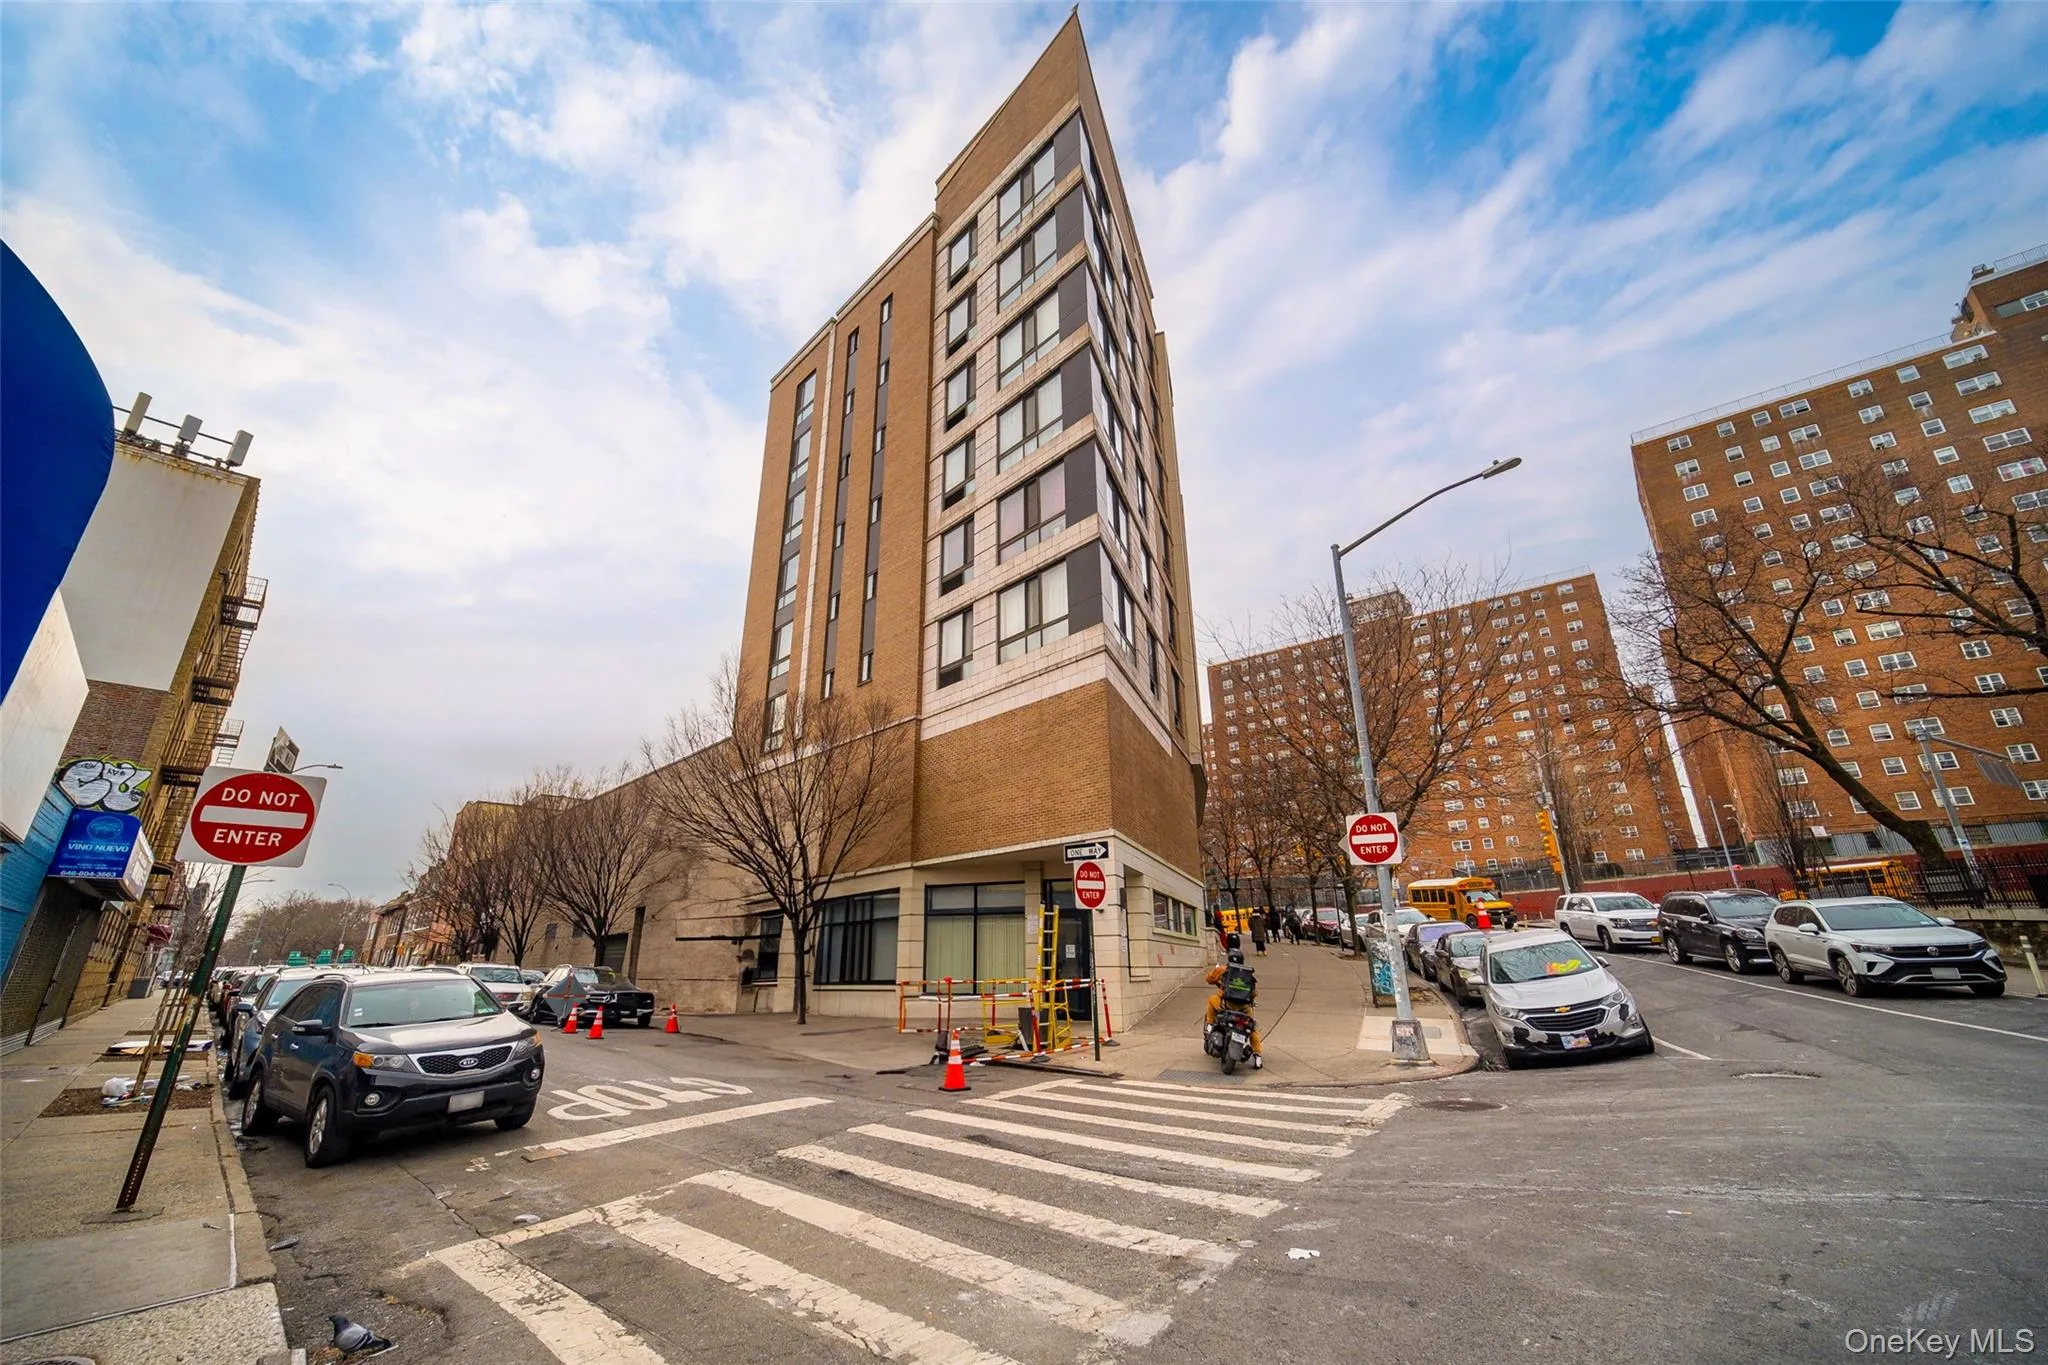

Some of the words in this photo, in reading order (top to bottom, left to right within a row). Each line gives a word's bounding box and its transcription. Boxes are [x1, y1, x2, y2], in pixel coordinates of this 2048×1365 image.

[221, 787, 251, 803] DO
[258, 790, 300, 807] NOT
[1355, 824, 1368, 833] DO
[1370, 823, 1387, 832] NOT
[213, 828, 282, 847] ENTER
[94, 845, 129, 853] NUEVO
[1070, 849, 1083, 857] ONE
[1088, 847, 1102, 855] WAY
[1360, 845, 1388, 855] ENTER
[1079, 870, 1088, 878] DO
[1089, 871, 1100, 879] NOT
[1082, 891, 1101, 900] ENTER
